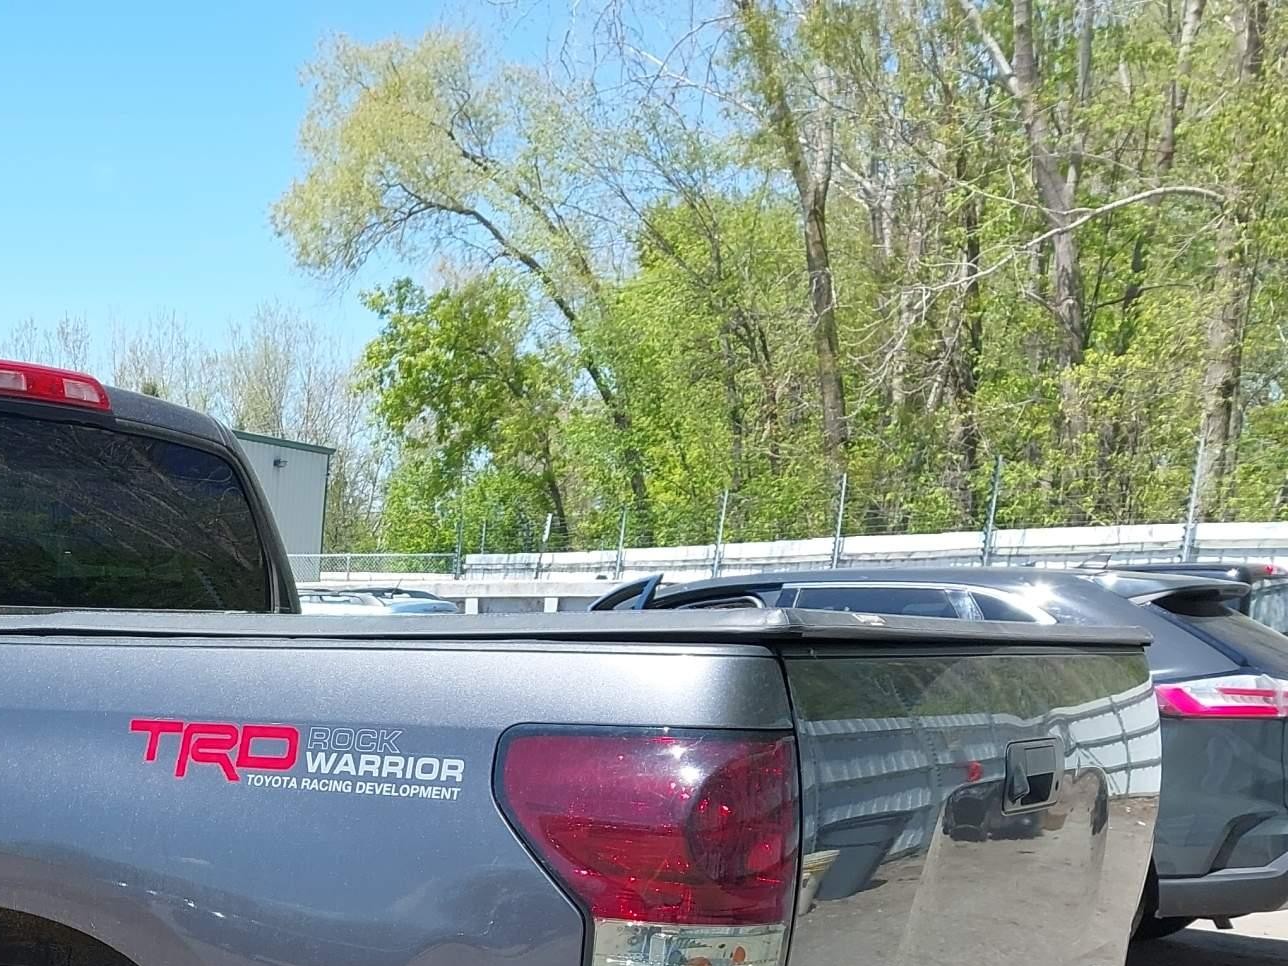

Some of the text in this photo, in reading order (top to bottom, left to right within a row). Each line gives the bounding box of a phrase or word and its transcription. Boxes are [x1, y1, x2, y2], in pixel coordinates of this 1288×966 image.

[130, 719, 300, 782] TRD
[307, 727, 403, 753] ROCK
[305, 752, 465, 782] WARRIOR
[247, 774, 461, 800] TOYOTA RACING DEVELOPMENT
